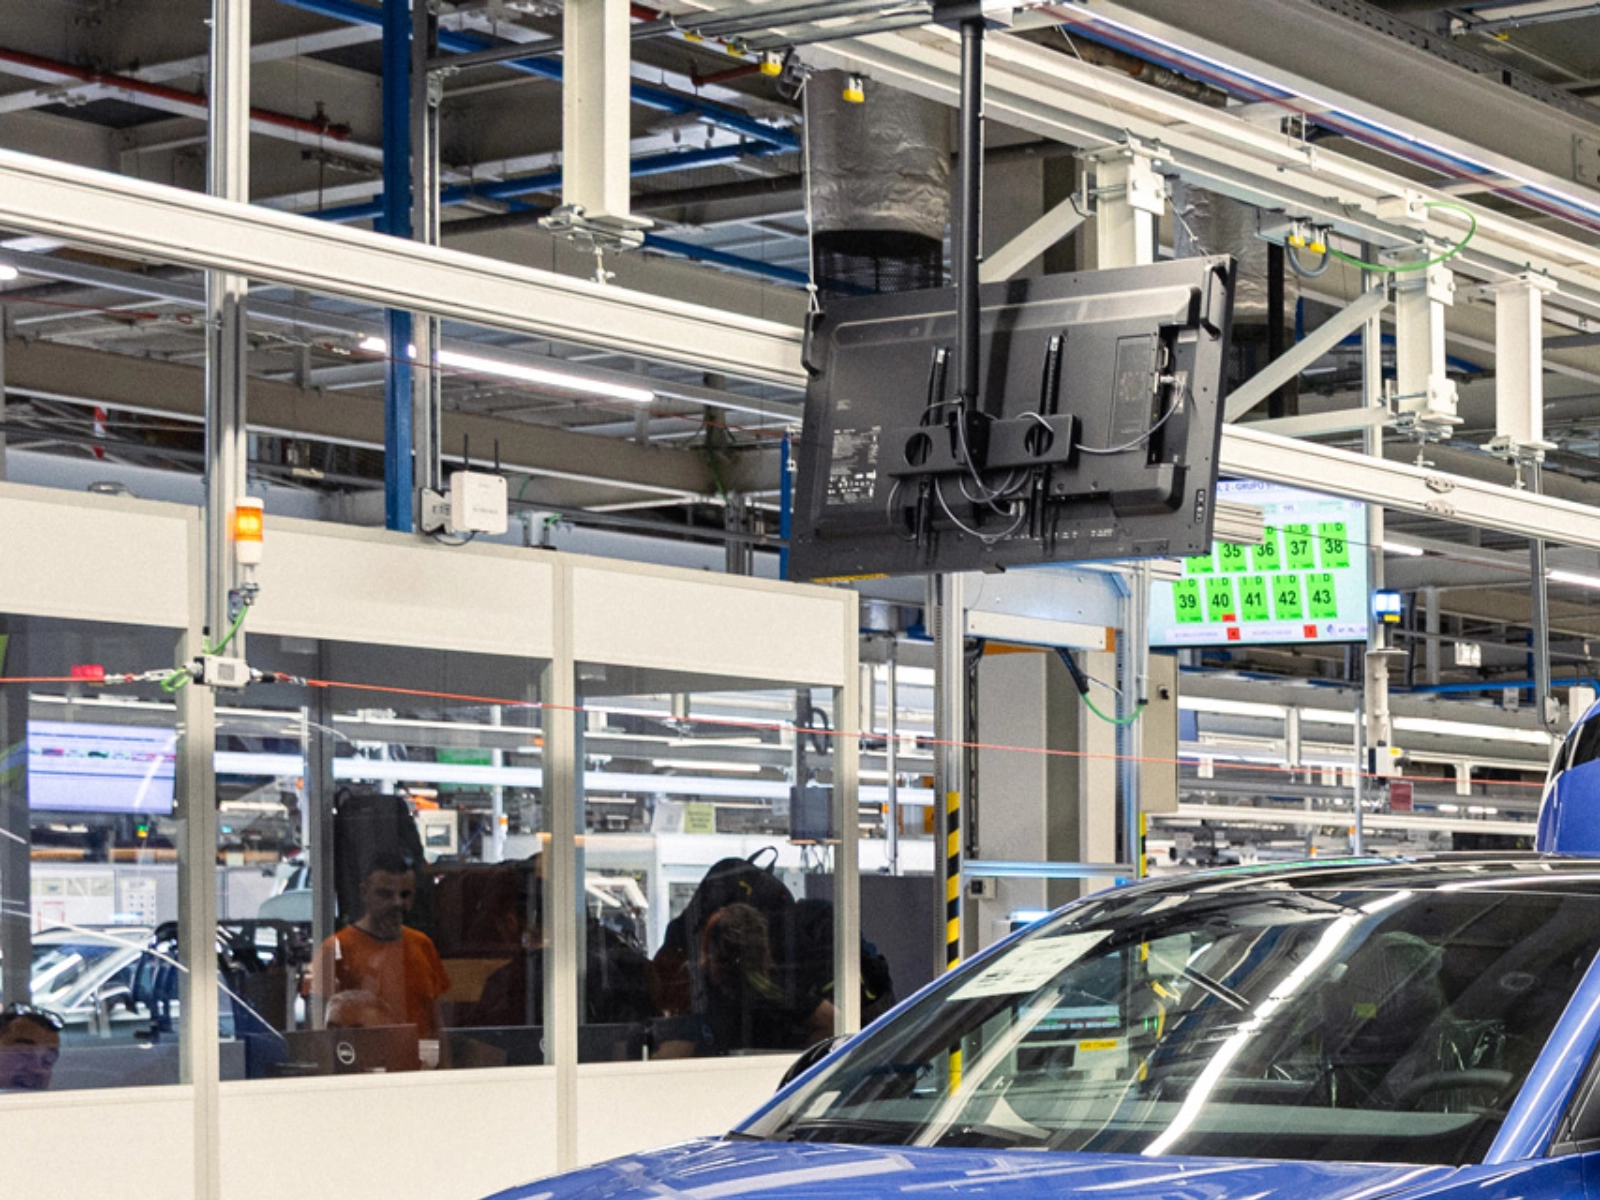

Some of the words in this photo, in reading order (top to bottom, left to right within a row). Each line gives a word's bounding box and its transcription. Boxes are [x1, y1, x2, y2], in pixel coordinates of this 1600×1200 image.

[1223, 543, 1241, 558] 35
[1257, 541, 1275, 557] 36
[1290, 540, 1308, 555] 37
[1325, 538, 1343, 554] 38
[1179, 593, 1197, 609] 39
[1212, 592, 1230, 608] 40
[1244, 591, 1262, 607] 41
[1278, 590, 1297, 606] 42
[1312, 588, 1332, 604] 43
